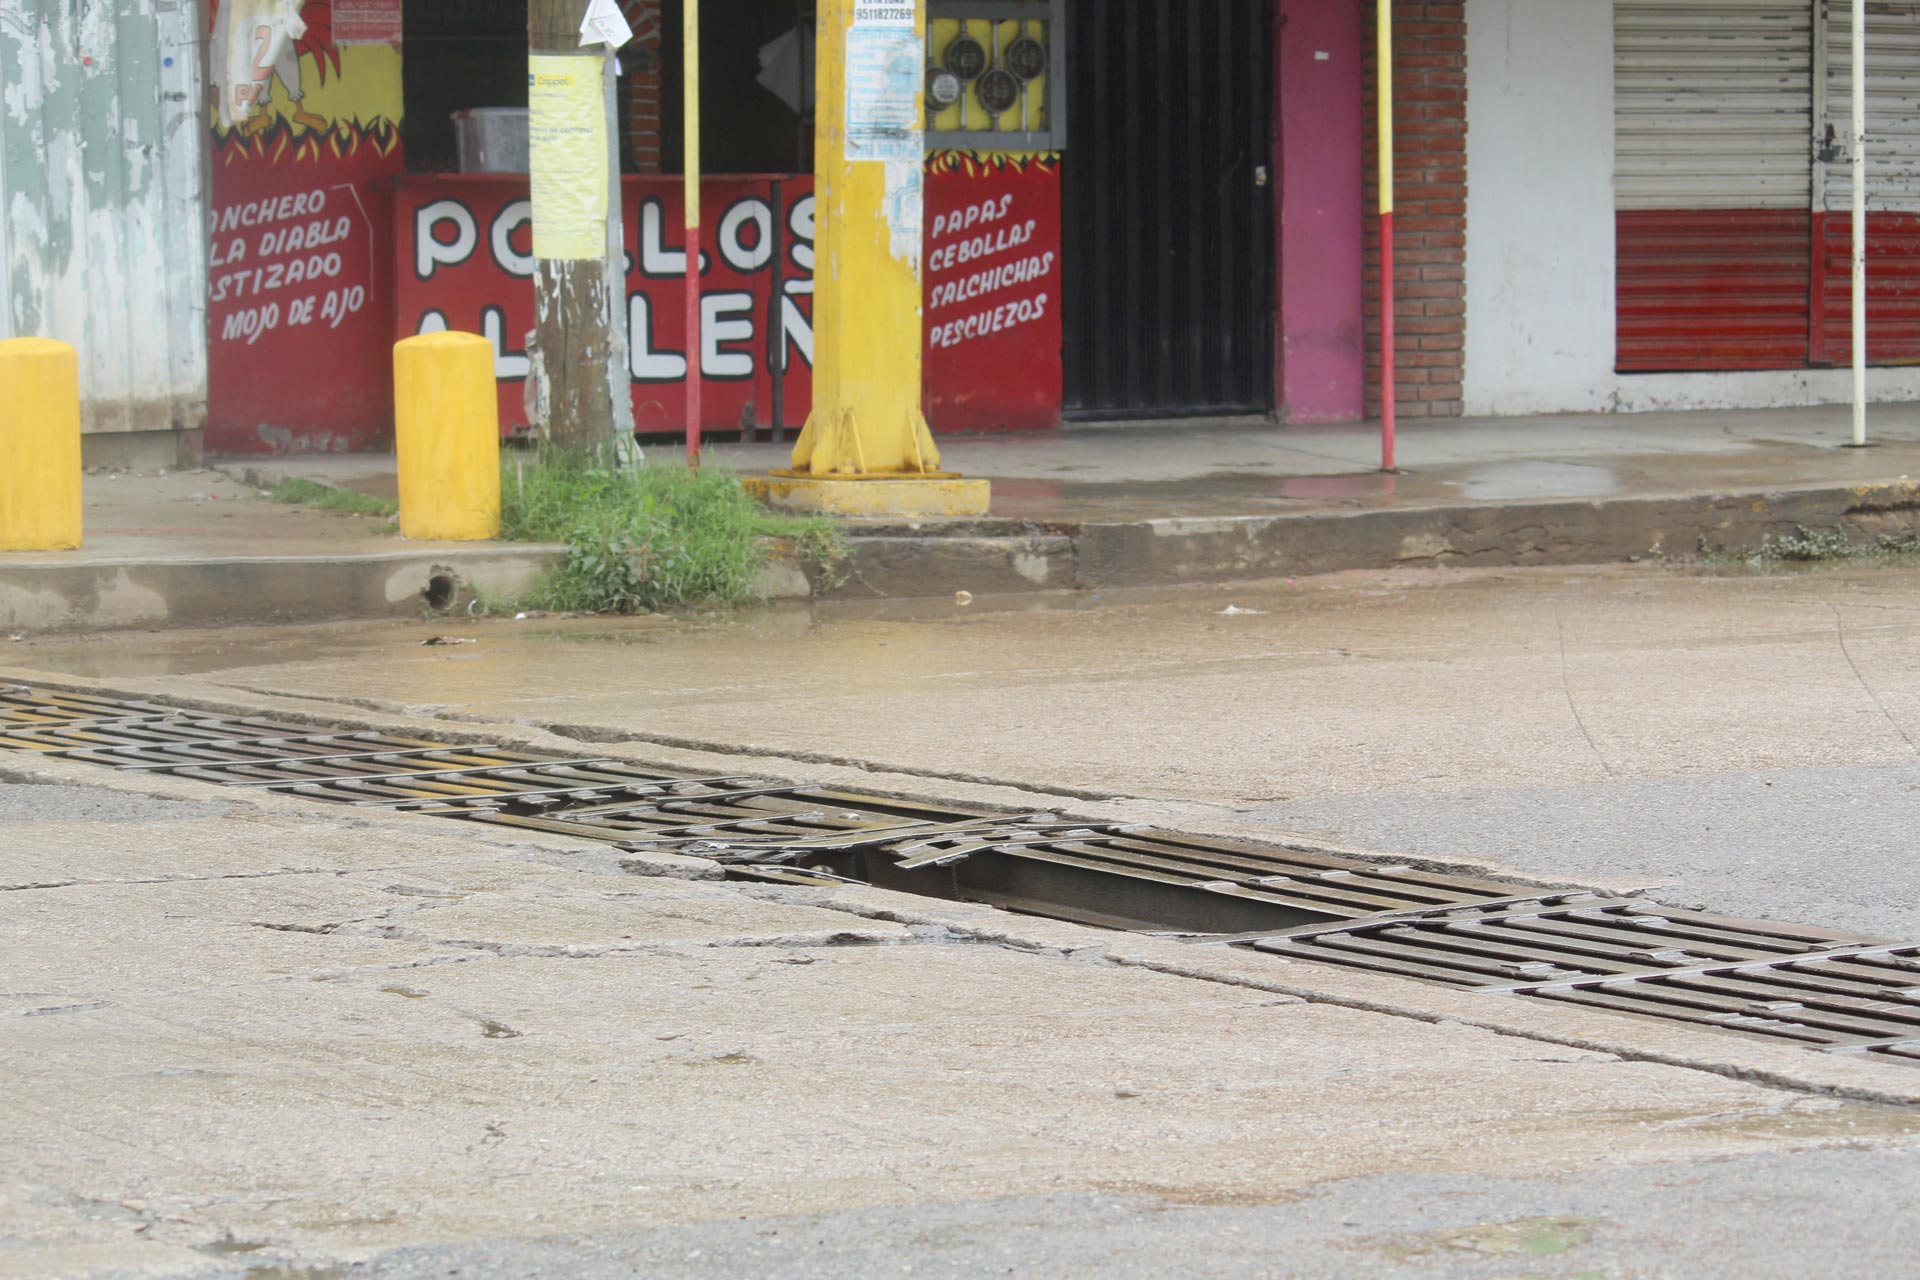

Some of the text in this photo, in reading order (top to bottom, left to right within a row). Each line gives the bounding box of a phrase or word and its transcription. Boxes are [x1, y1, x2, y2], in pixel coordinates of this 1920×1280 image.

[856, 8, 912, 20] 9511827269
[209, 216, 351, 267] LA DIABLA
[931, 193, 1013, 239] PAPAS
[929, 219, 1036, 271] CEBOLLAS
[929, 251, 1054, 310] SALCHICHAS
[221, 285, 365, 345] MOJO DE AJO
[929, 292, 1048, 349] PESCUEZOS
